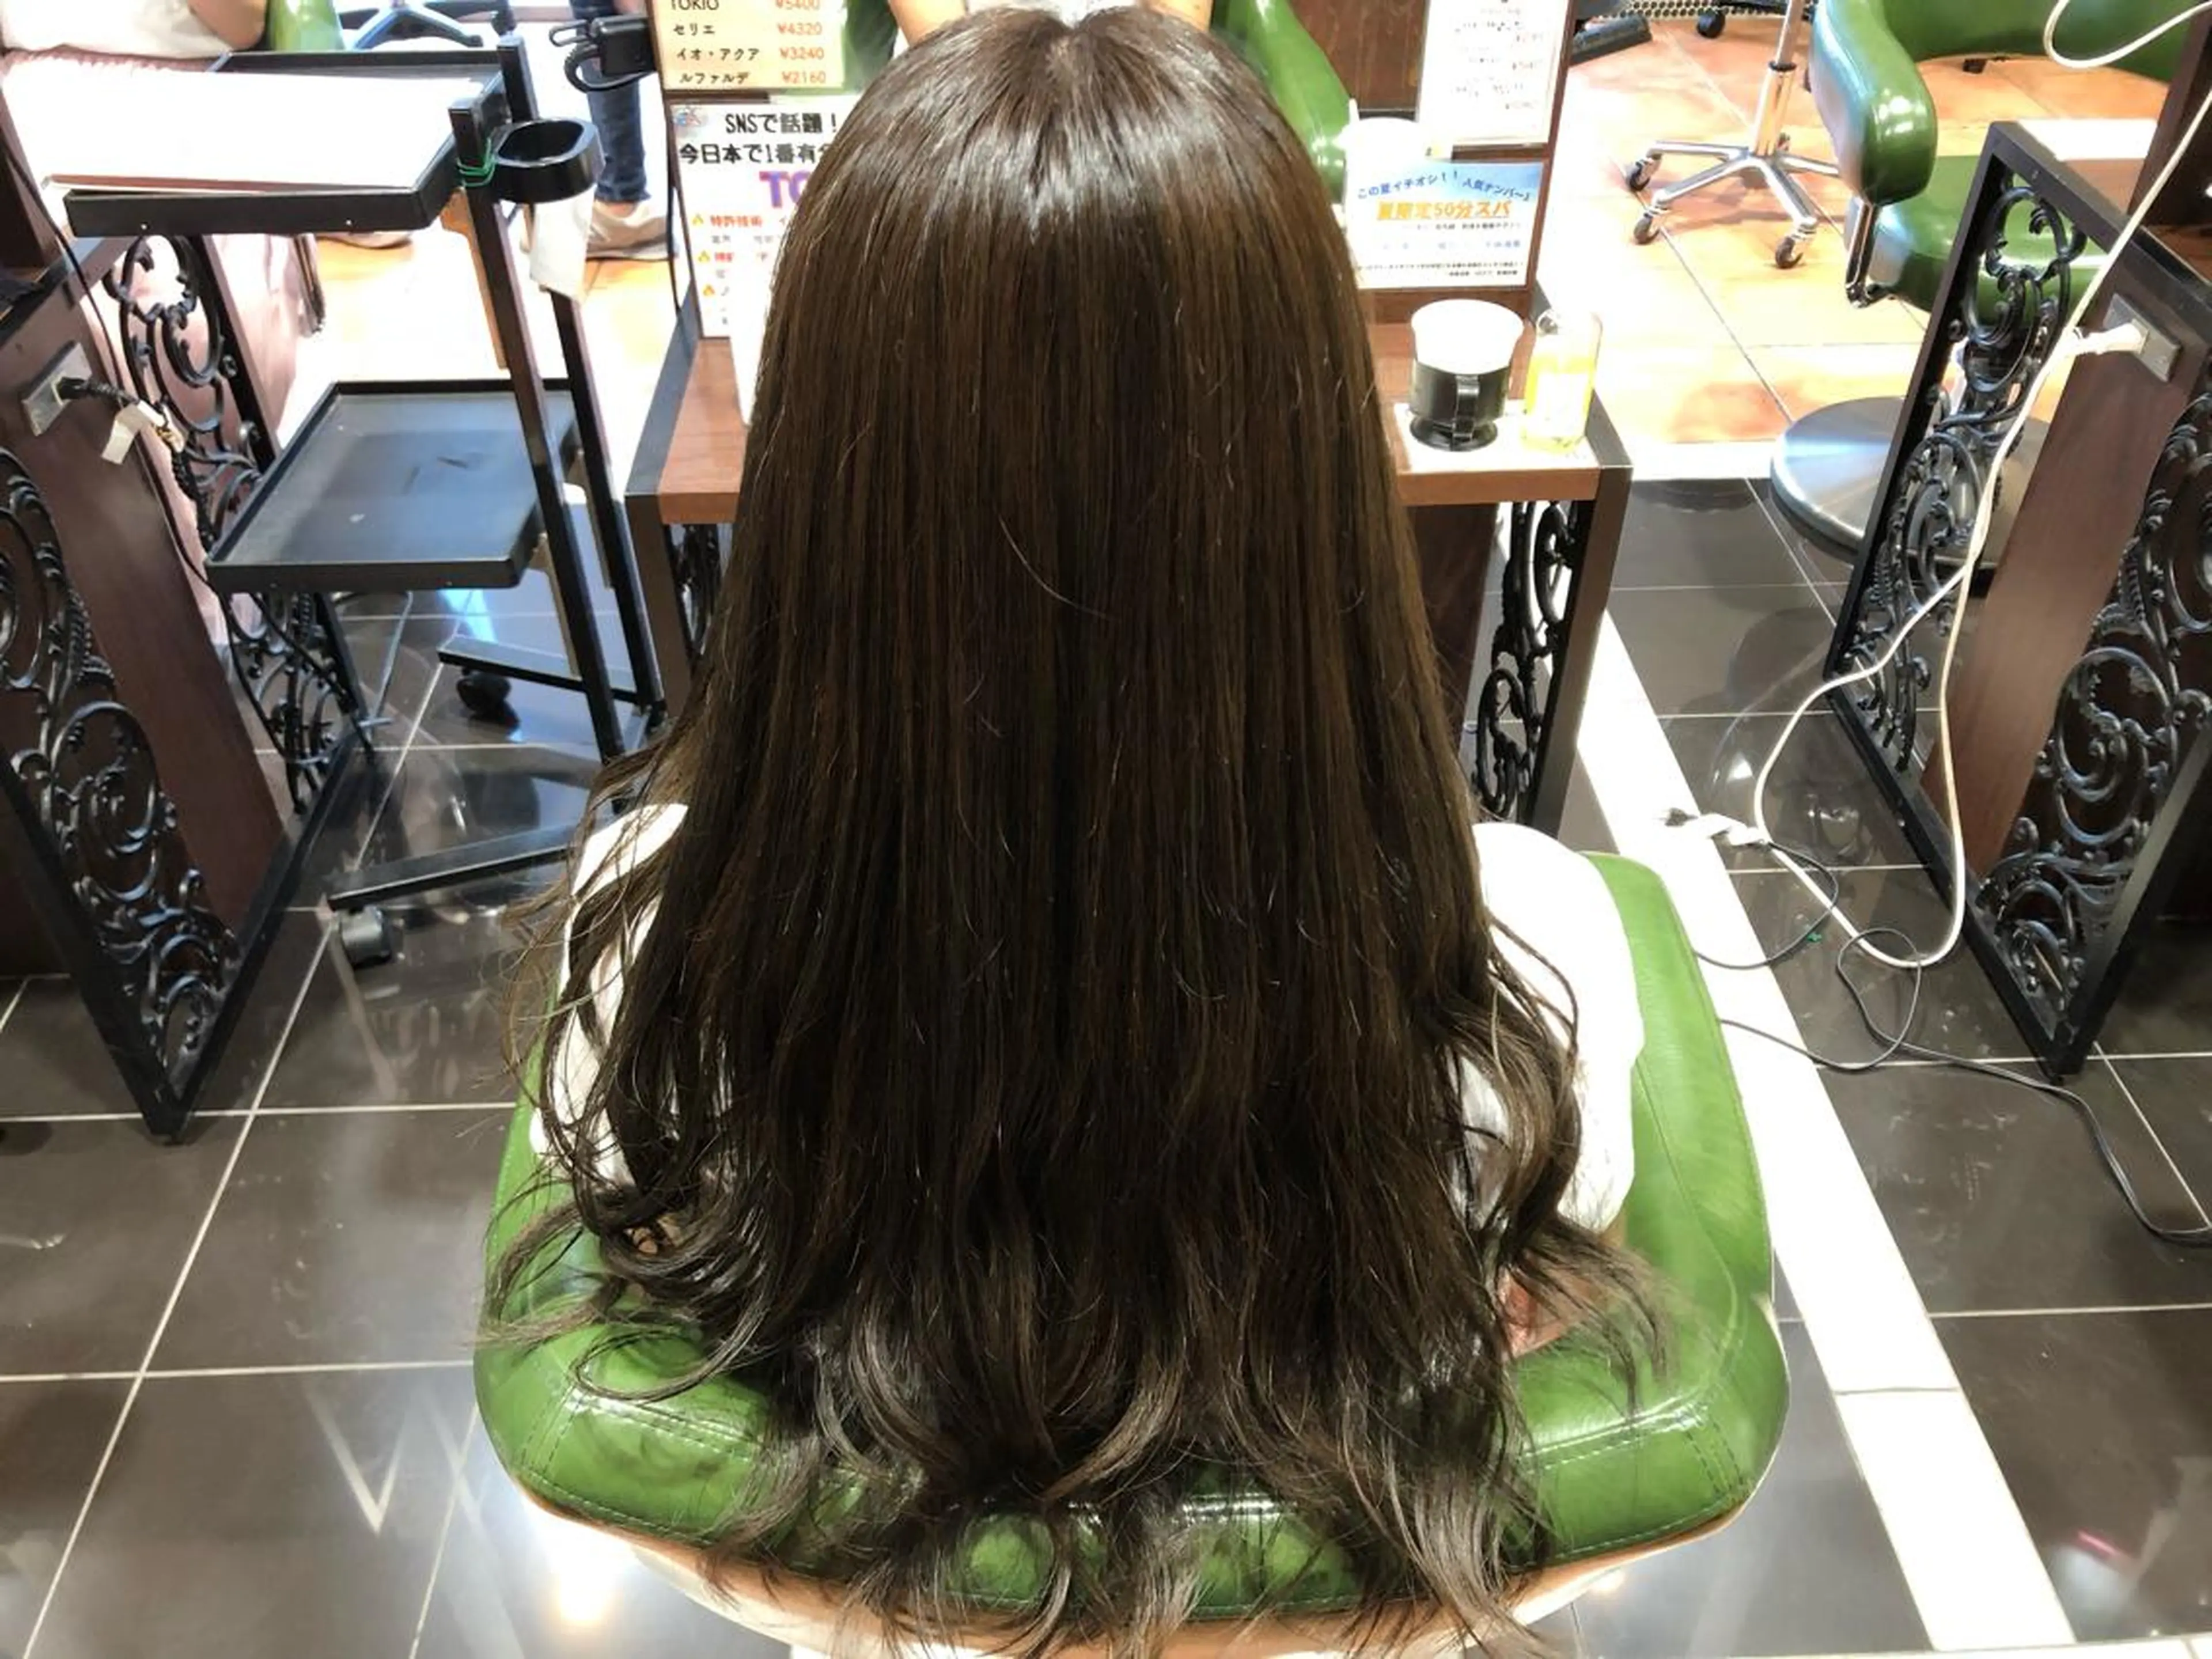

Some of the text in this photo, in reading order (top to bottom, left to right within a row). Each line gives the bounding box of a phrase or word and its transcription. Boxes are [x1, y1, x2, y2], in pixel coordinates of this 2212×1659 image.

[673, 23, 715, 36] セリエ
[777, 21, 823, 35] ¥4320
[779, 46, 825, 60] ¥3240
[781, 70, 827, 84] ¥2160
